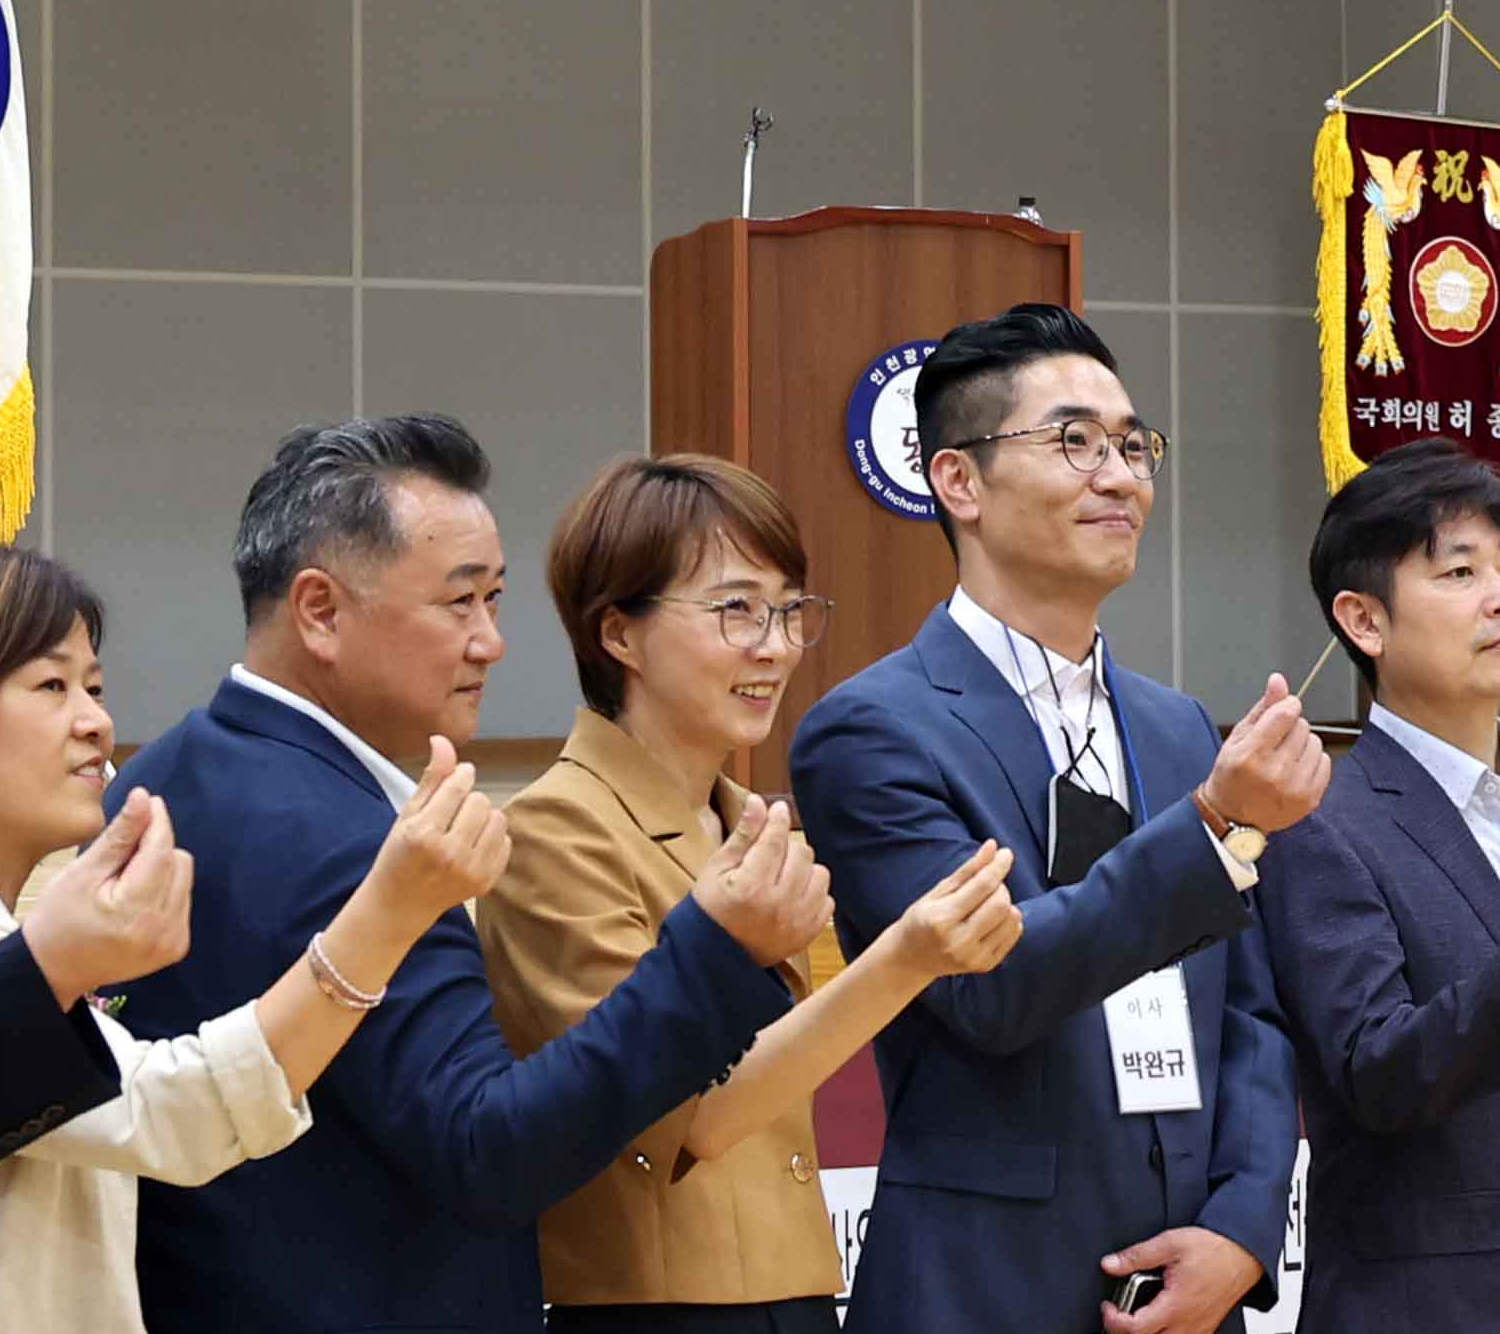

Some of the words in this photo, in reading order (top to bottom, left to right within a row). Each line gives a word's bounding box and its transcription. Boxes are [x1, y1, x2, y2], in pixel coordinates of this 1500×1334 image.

[1430, 149, 1474, 204] 祝
[1353, 397, 1441, 433] 국회의원
[1122, 1048, 1185, 1080] 박완규
